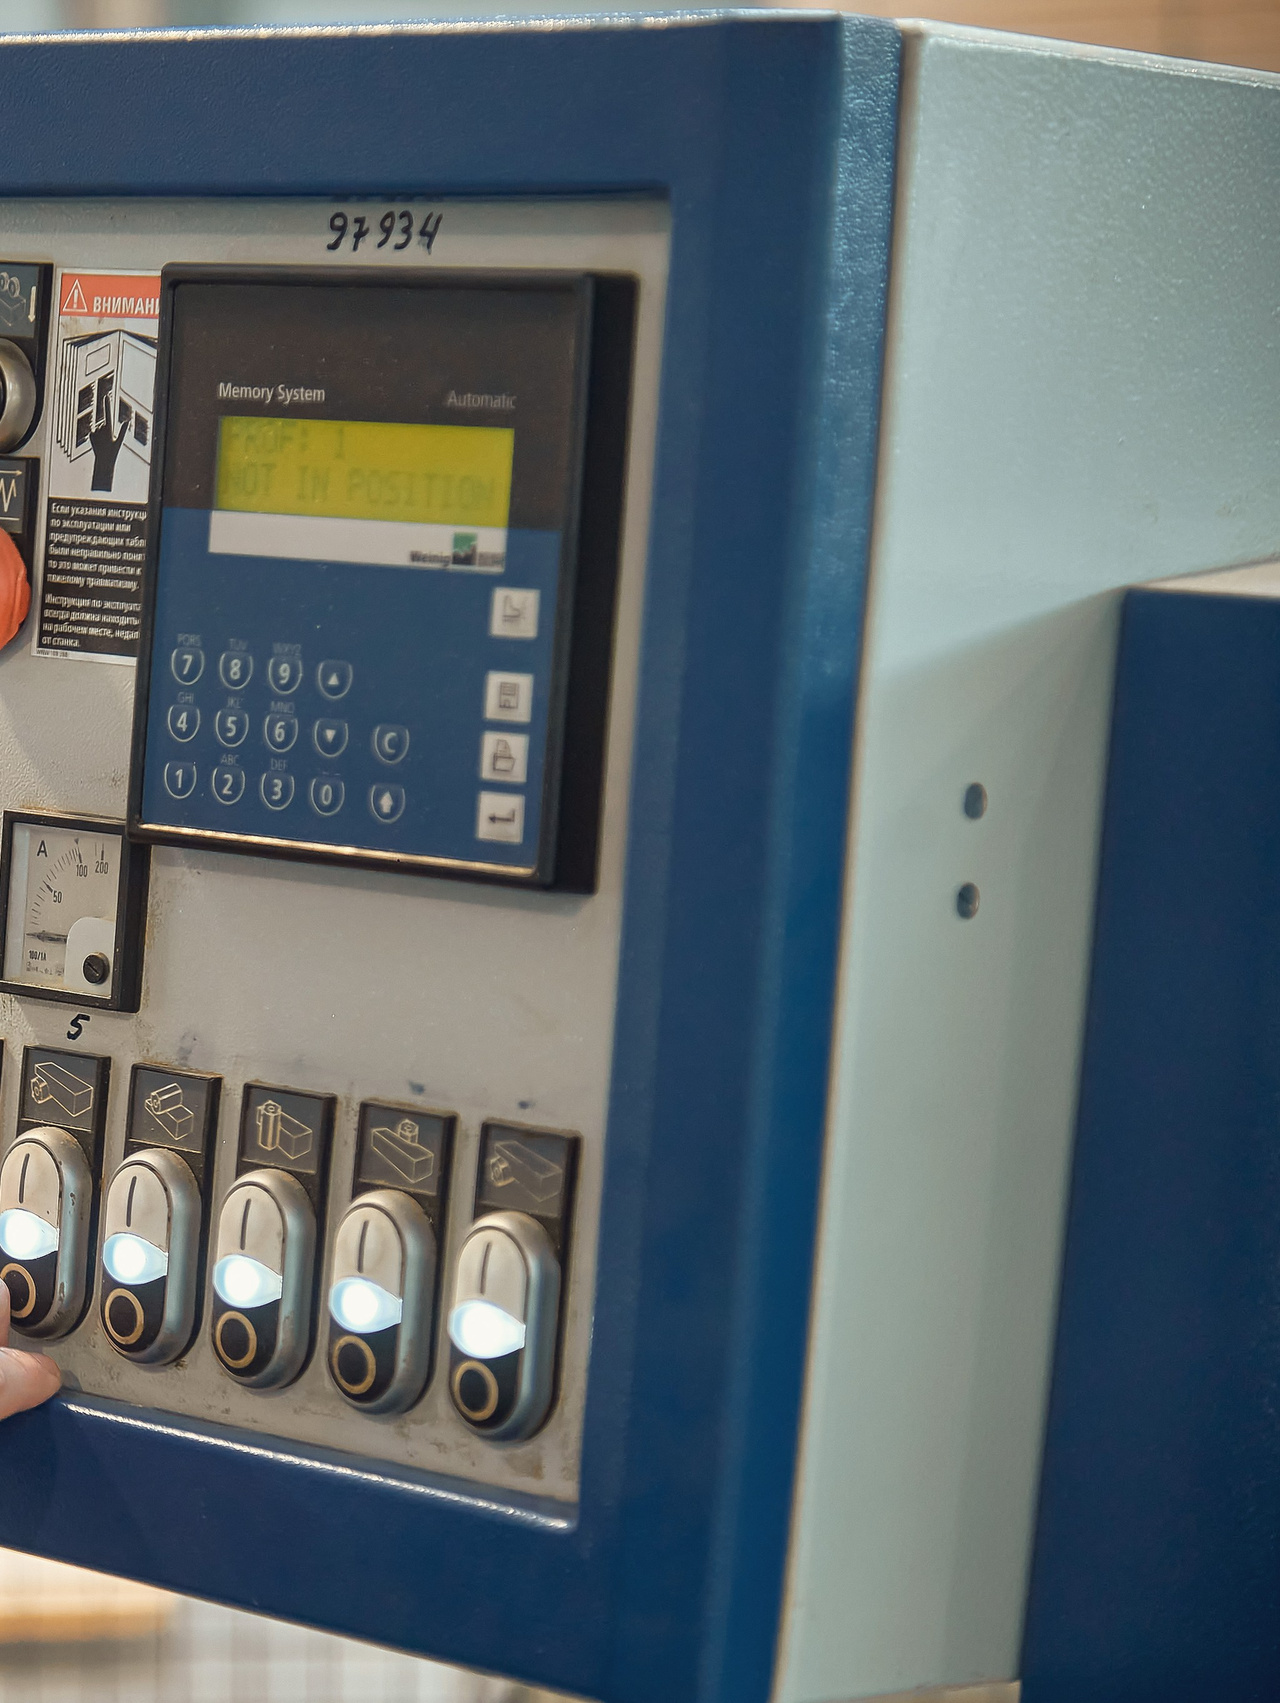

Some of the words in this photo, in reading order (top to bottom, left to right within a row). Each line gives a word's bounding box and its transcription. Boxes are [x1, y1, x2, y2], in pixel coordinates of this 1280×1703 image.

[327, 210, 443, 255] 97934
[219, 382, 273, 403] Memory
[278, 384, 326, 404] System
[447, 390, 517, 409] Automatic
[223, 462, 277, 496] NOT
[297, 465, 331, 502] IN
[348, 467, 495, 511] POSITION
[51, 502, 70, 515] Если
[71, 505, 106, 517] указания
[50, 518, 61, 528] по
[62, 520, 115, 532] эксплуатации
[115, 523, 131, 532] или
[49, 532, 124, 547] предупреждающих
[125, 535, 147, 547] табл
[49, 543, 70, 556] были
[70, 547, 122, 560] неправильно
[58, 560, 71, 570] это
[72, 562, 97, 572] может
[98, 564, 136, 576] привести
[47, 573, 86, 588] тяжелому
[43, 609, 70, 621] всегда
[70, 611, 101, 622] должна
[43, 623, 53, 632] на
[53, 621, 88, 634] рабочем
[88, 627, 114, 638] месте,
[115, 629, 141, 641] недал
[42, 636, 52, 645] от
[52, 637, 80, 648] станка.
[182, 654, 193, 675] 7
[230, 659, 241, 680] 8
[279, 663, 290, 684] 9
[177, 712, 188, 732] 4
[226, 716, 237, 737] 5
[275, 721, 286, 742] 6
[175, 769, 183, 789] 1
[222, 774, 233, 795] 2
[271, 779, 283, 800] 3
[321, 784, 332, 805] 0
[36, 840, 48, 858] A
[76, 864, 88, 878] 100
[95, 861, 109, 875] 200
[53, 890, 63, 904] 50
[66, 1013, 91, 1040] 5
